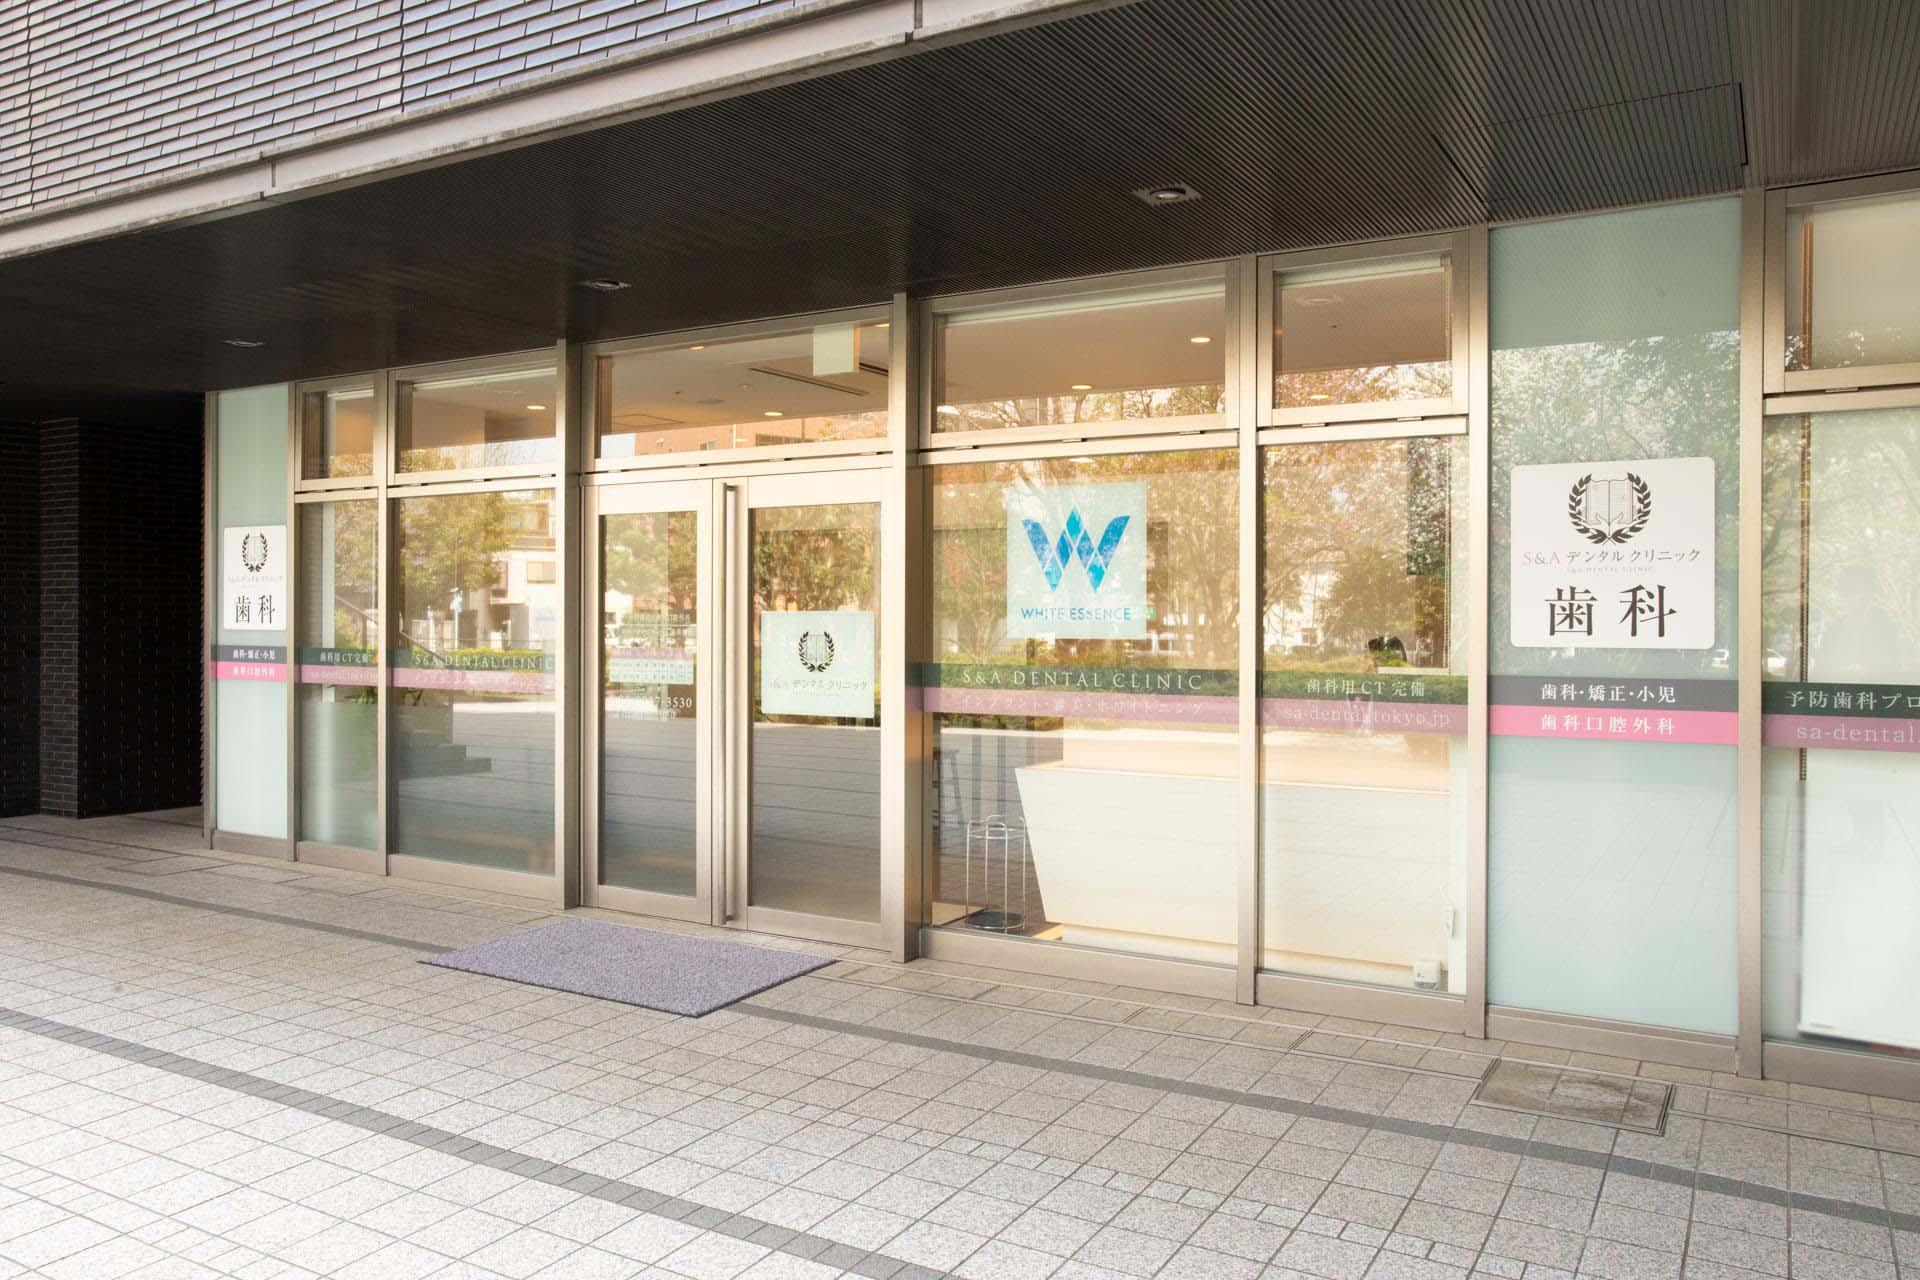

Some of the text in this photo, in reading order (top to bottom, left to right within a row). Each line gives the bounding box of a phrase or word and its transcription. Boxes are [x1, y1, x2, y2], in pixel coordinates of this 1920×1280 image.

[1523, 549, 1700, 565] S&A デンタル クリニック
[234, 595, 276, 624] 歯科
[1020, 607, 1132, 621] WHITE ESSENCE
[1545, 584, 1678, 638] 歯科
[415, 654, 553, 669] S&A DENTAL CLINIC
[963, 669, 1202, 690] S&A DENTAL CLINIC
[1306, 680, 1425, 697] 歯科用 CT 完備
[1784, 690, 1920, 711] 予防歯科プロ
[1541, 714, 1675, 736] 歯科口腔外科
